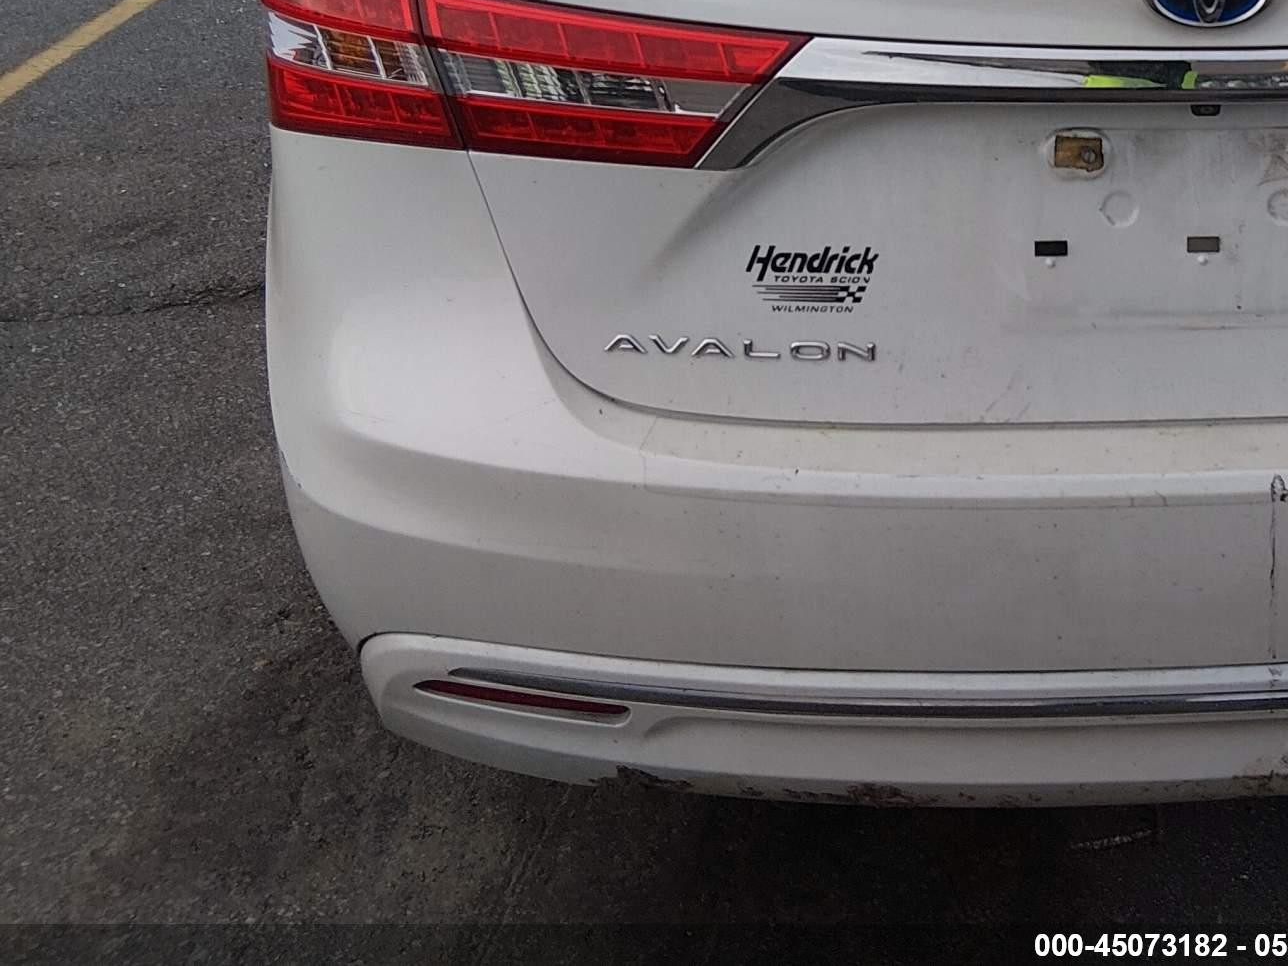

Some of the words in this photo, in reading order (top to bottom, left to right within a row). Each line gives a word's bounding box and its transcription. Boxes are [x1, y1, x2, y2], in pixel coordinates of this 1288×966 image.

[745, 244, 880, 282] Hendrick
[774, 275, 824, 283] TOYOTA
[771, 305, 855, 314] WILMINGTON
[603, 334, 876, 361] AVALON
